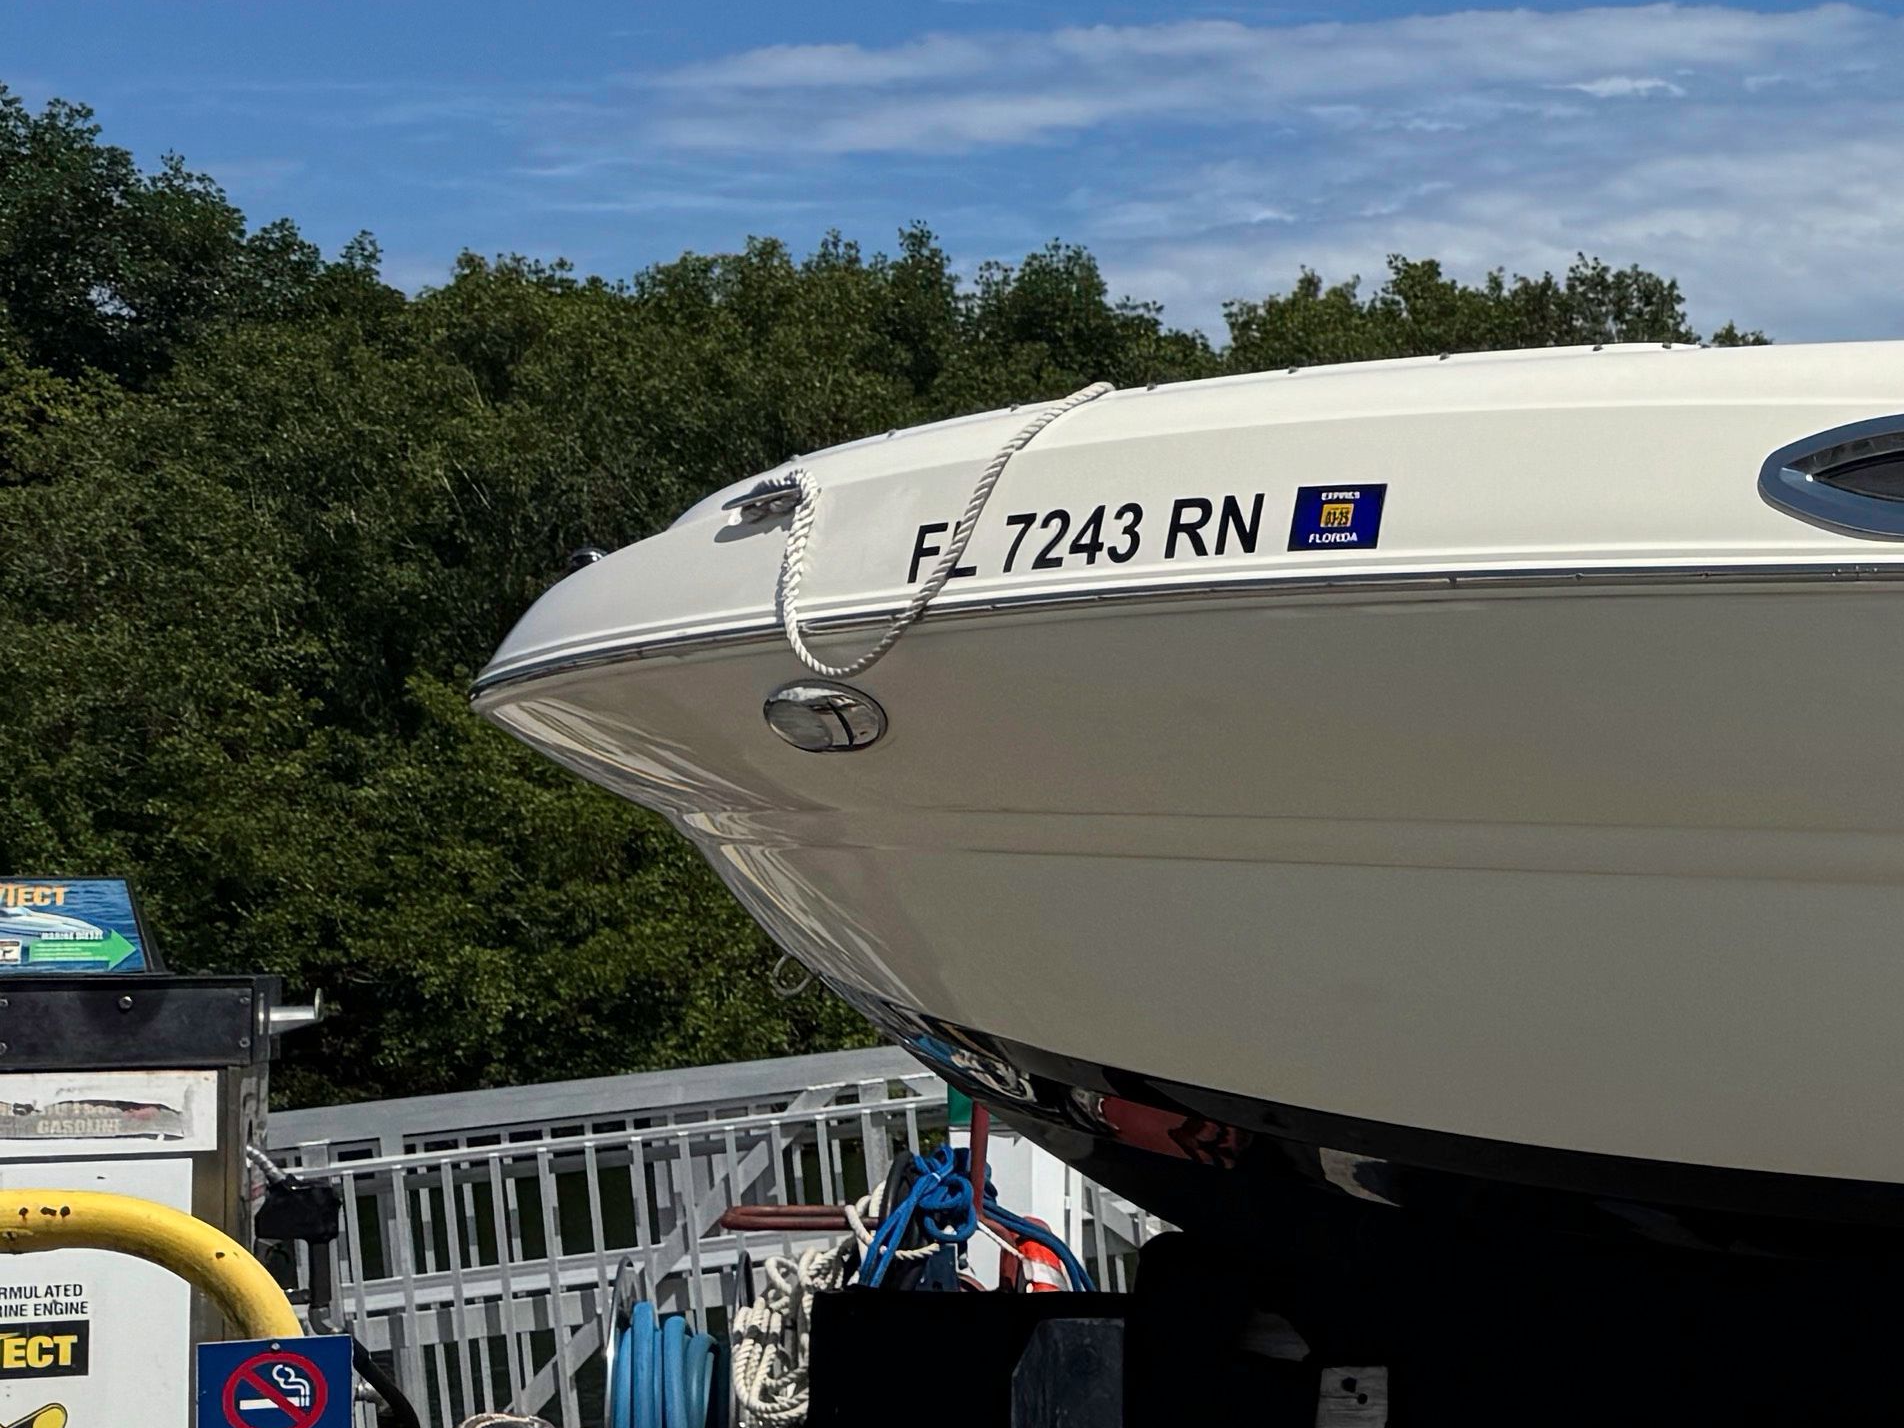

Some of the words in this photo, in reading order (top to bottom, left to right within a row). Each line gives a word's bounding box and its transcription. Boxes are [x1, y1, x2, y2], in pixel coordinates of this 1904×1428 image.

[1002, 502, 1143, 573] 7243
[1164, 493, 1265, 559] RN
[1308, 532, 1358, 543] FLORIDA
[0, 883, 68, 907] TECT
[33, 1301, 89, 1316] ENGINE
[0, 1332, 78, 1369] ECT
